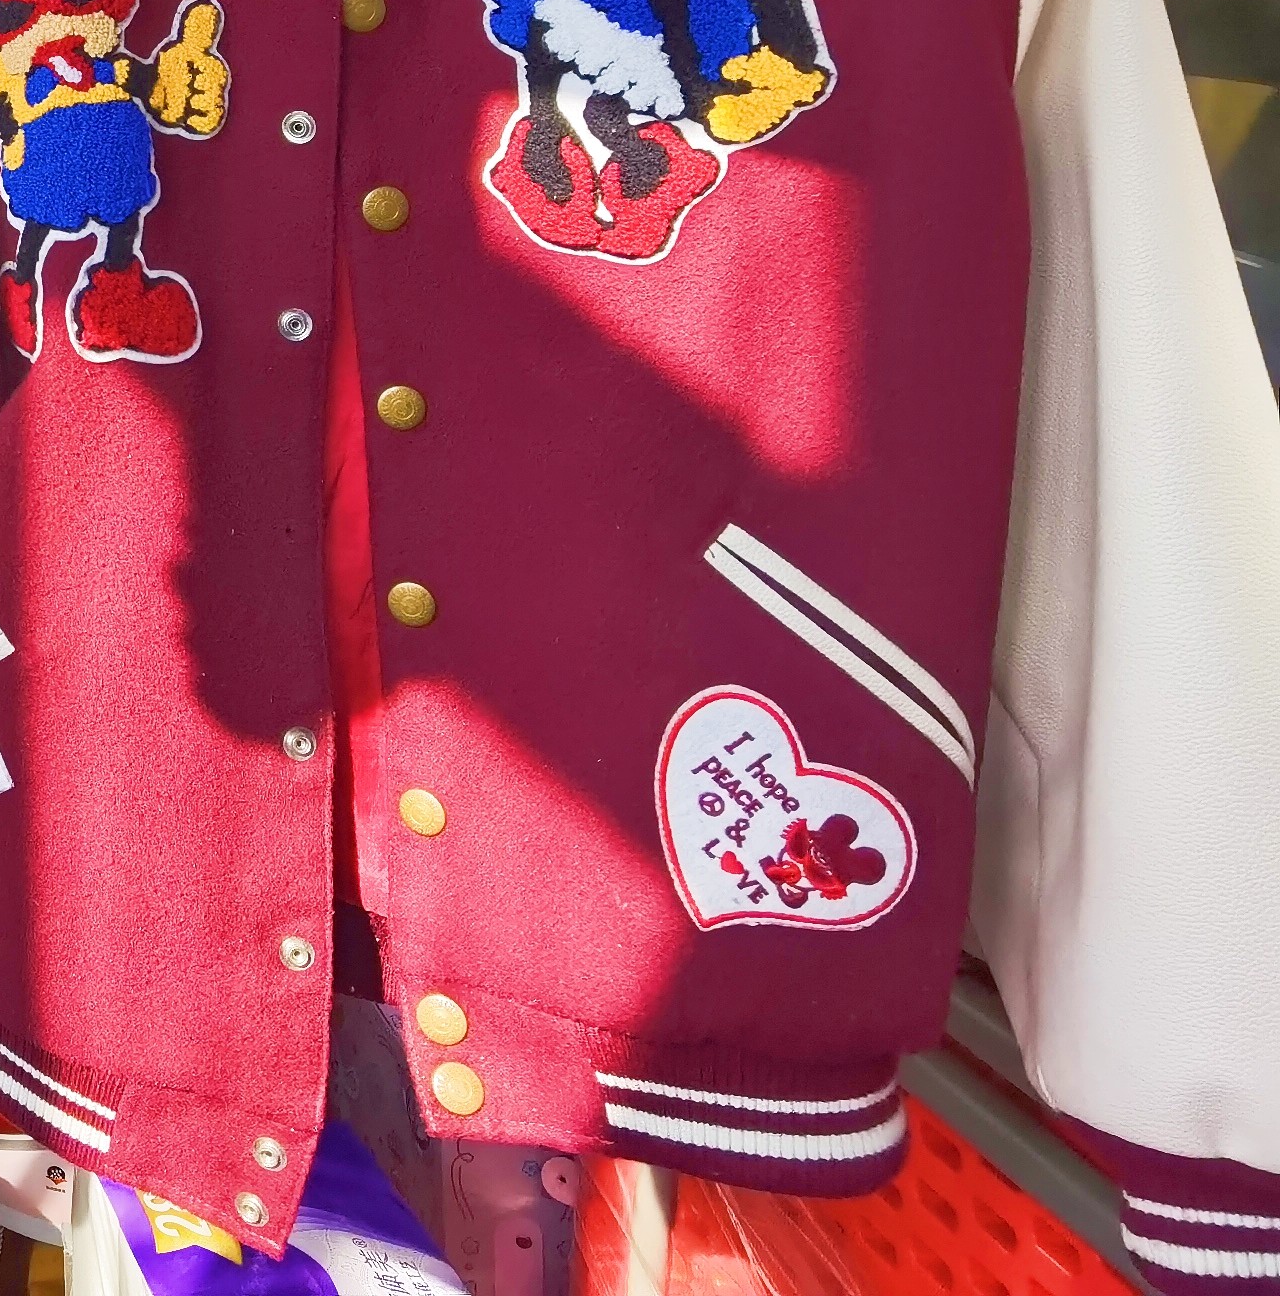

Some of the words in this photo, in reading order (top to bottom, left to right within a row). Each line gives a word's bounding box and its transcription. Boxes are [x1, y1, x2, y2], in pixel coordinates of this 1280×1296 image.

[691, 755, 765, 819] PEACE
[723, 731, 755, 756] I
[744, 753, 801, 814] hope
